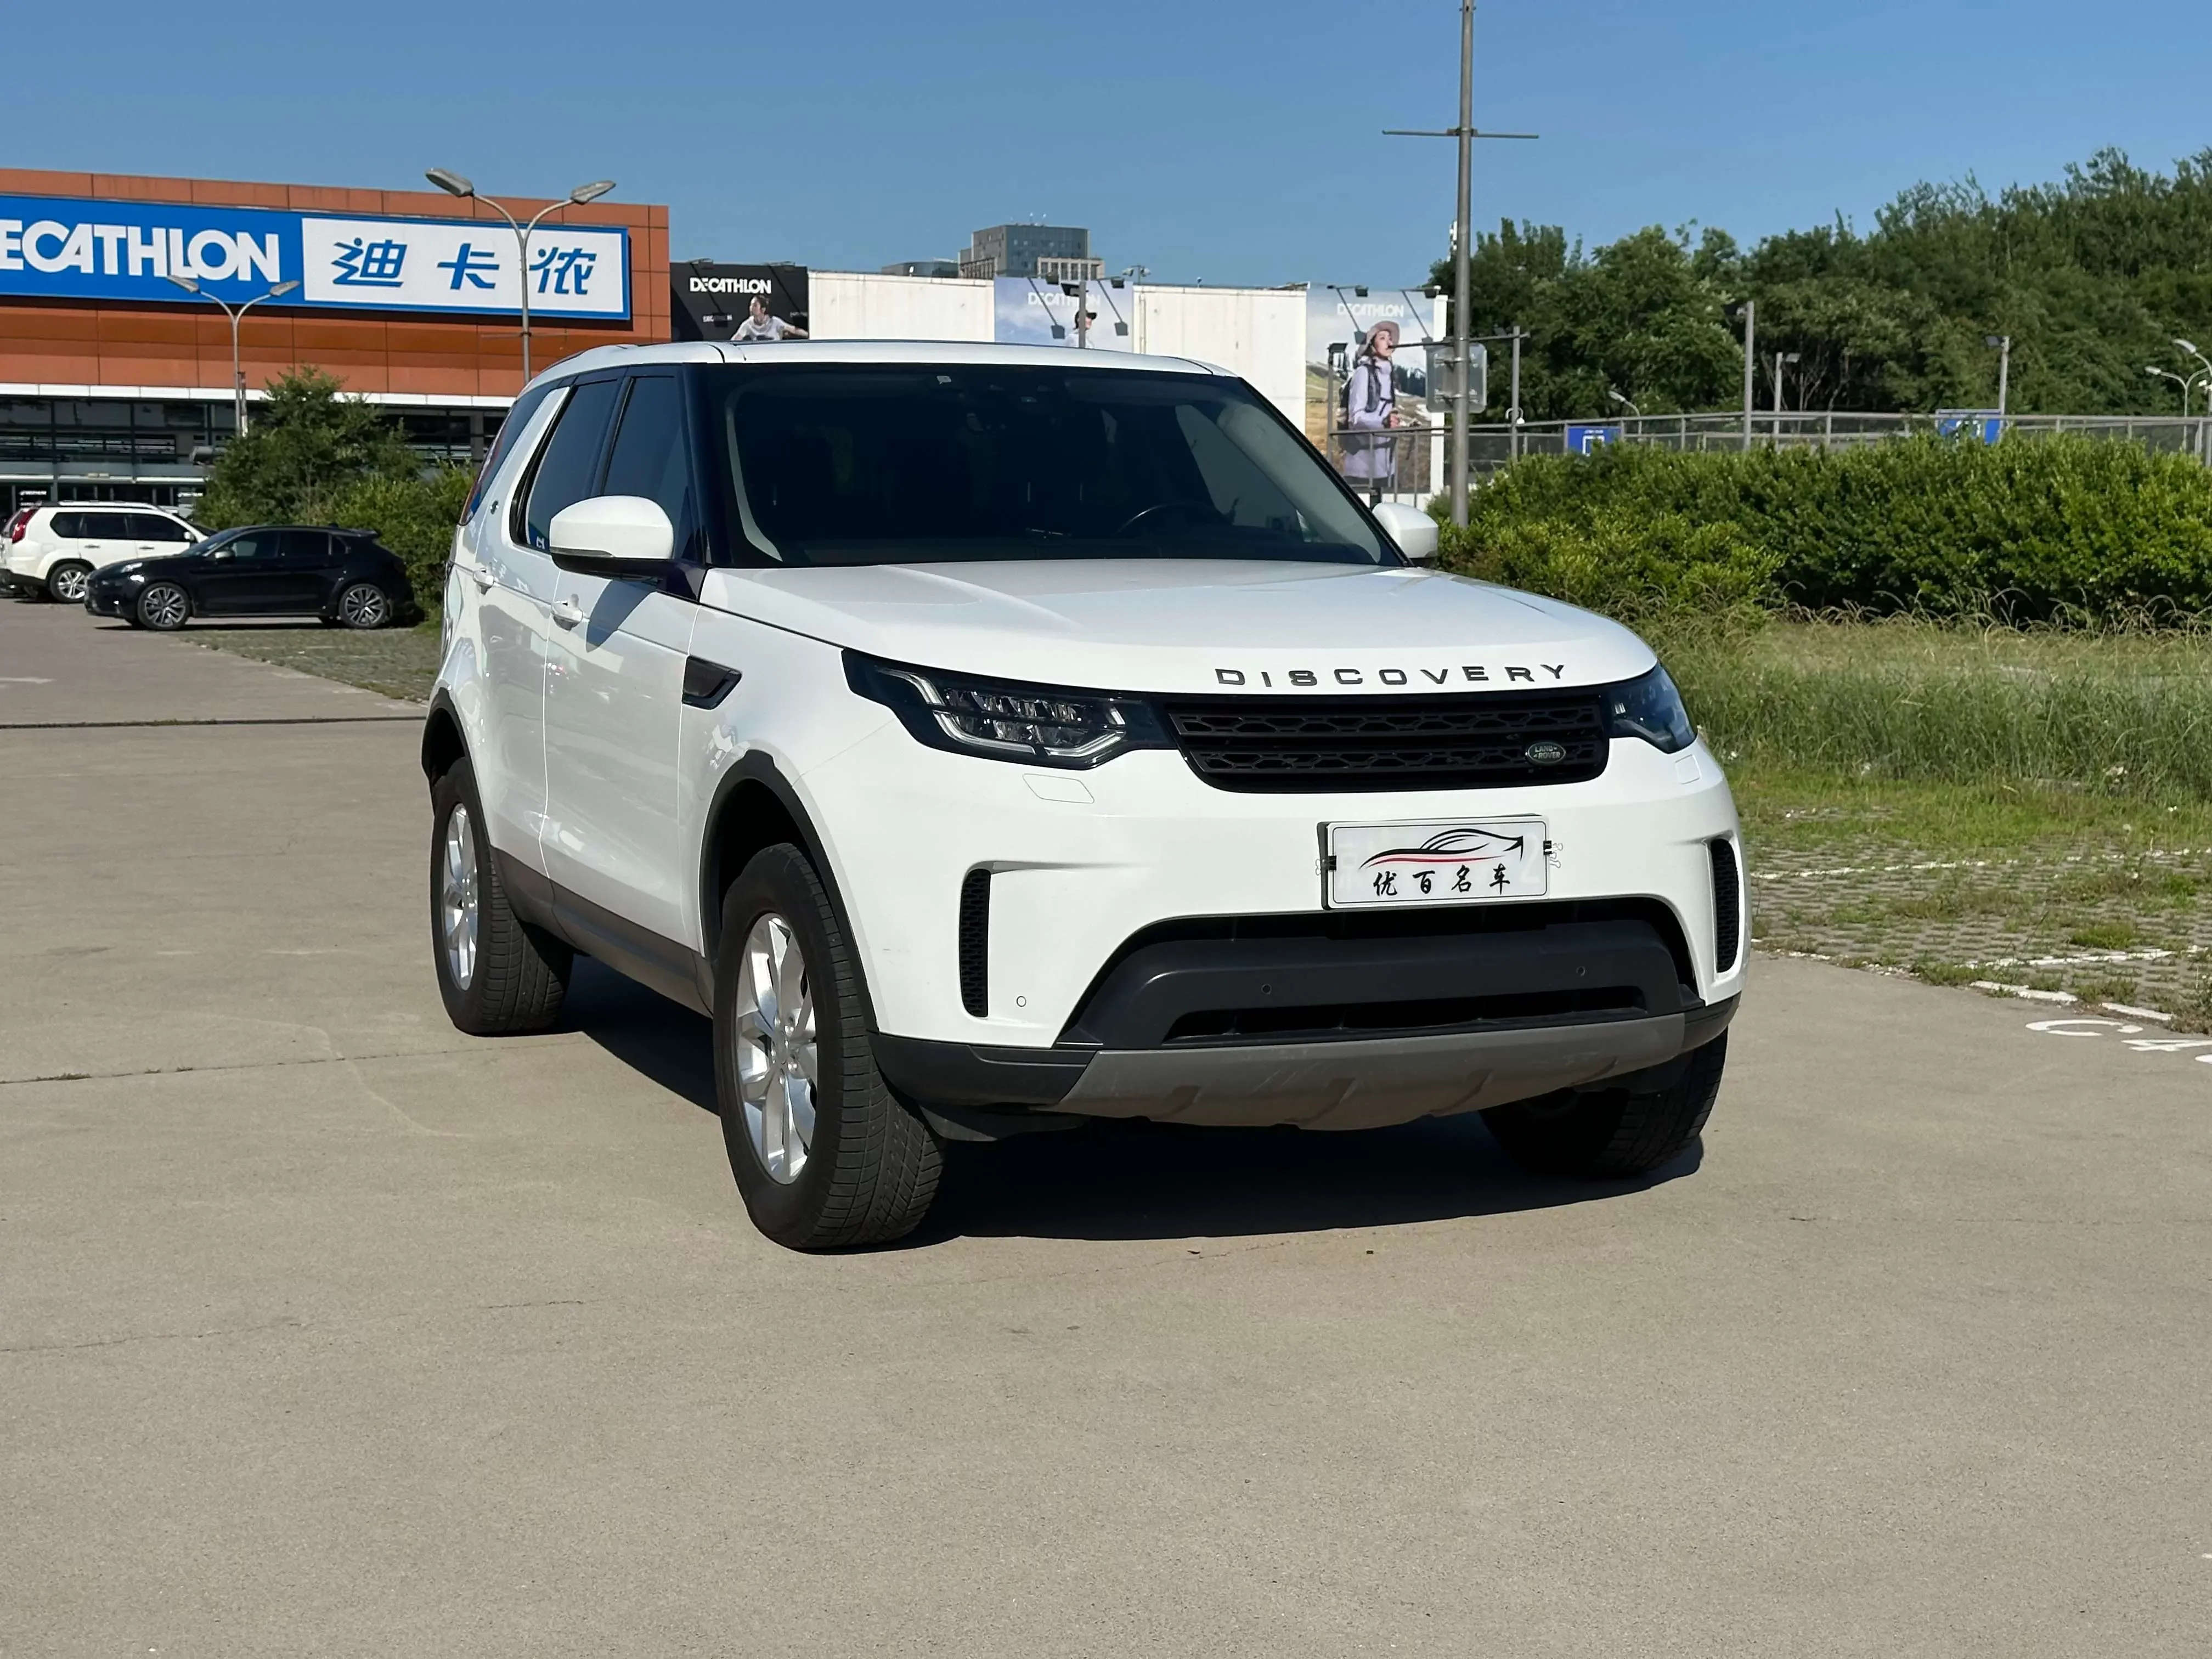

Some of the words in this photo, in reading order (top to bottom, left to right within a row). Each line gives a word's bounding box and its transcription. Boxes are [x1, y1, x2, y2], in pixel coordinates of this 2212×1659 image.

[331, 238, 596, 295] 迪卡侬
[690, 277, 772, 294] DECATHLON
[1215, 664, 1565, 687] DISCOVERY
[1373, 863, 1510, 896] 优百名车
